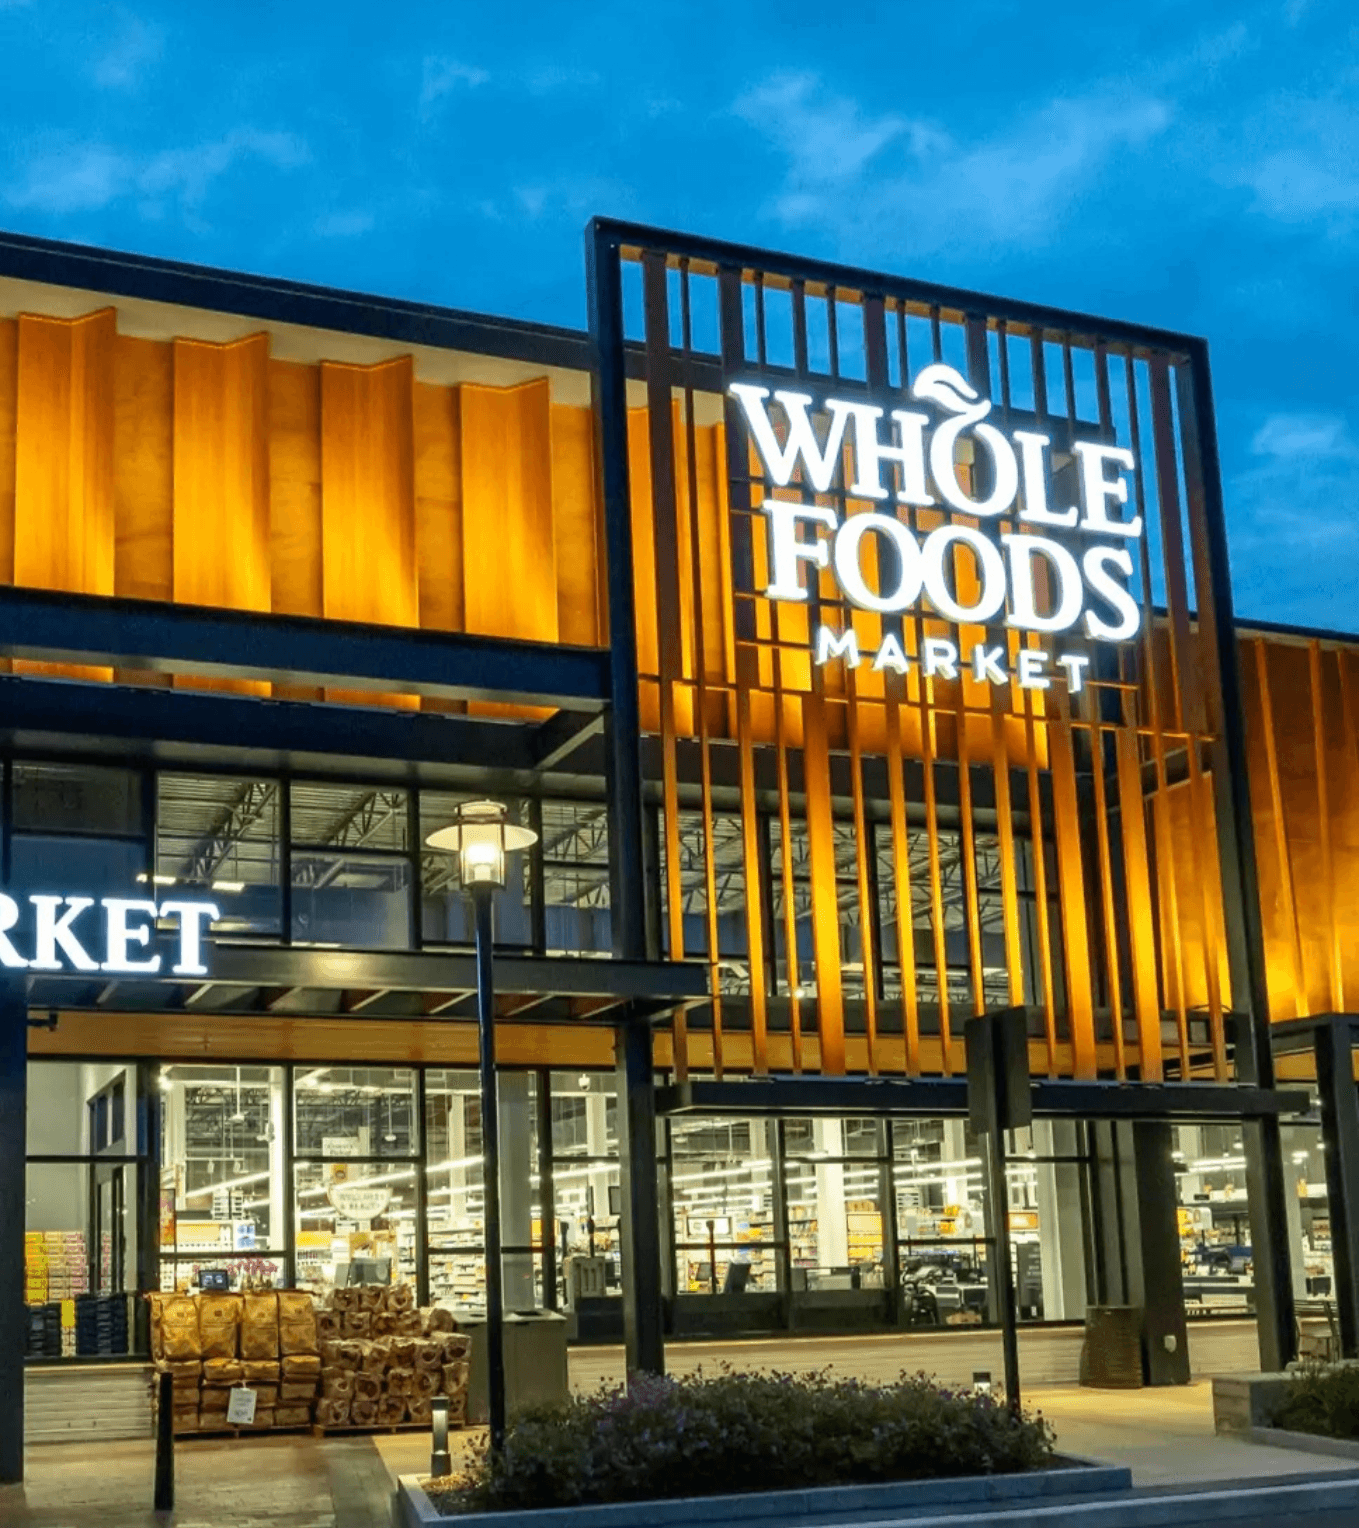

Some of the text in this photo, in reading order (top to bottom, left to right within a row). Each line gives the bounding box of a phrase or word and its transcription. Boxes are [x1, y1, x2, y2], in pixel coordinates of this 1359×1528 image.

[728, 363, 1143, 538] WHOLE
[762, 498, 1141, 642] FOODS
[814, 625, 1090, 694] MARKET
